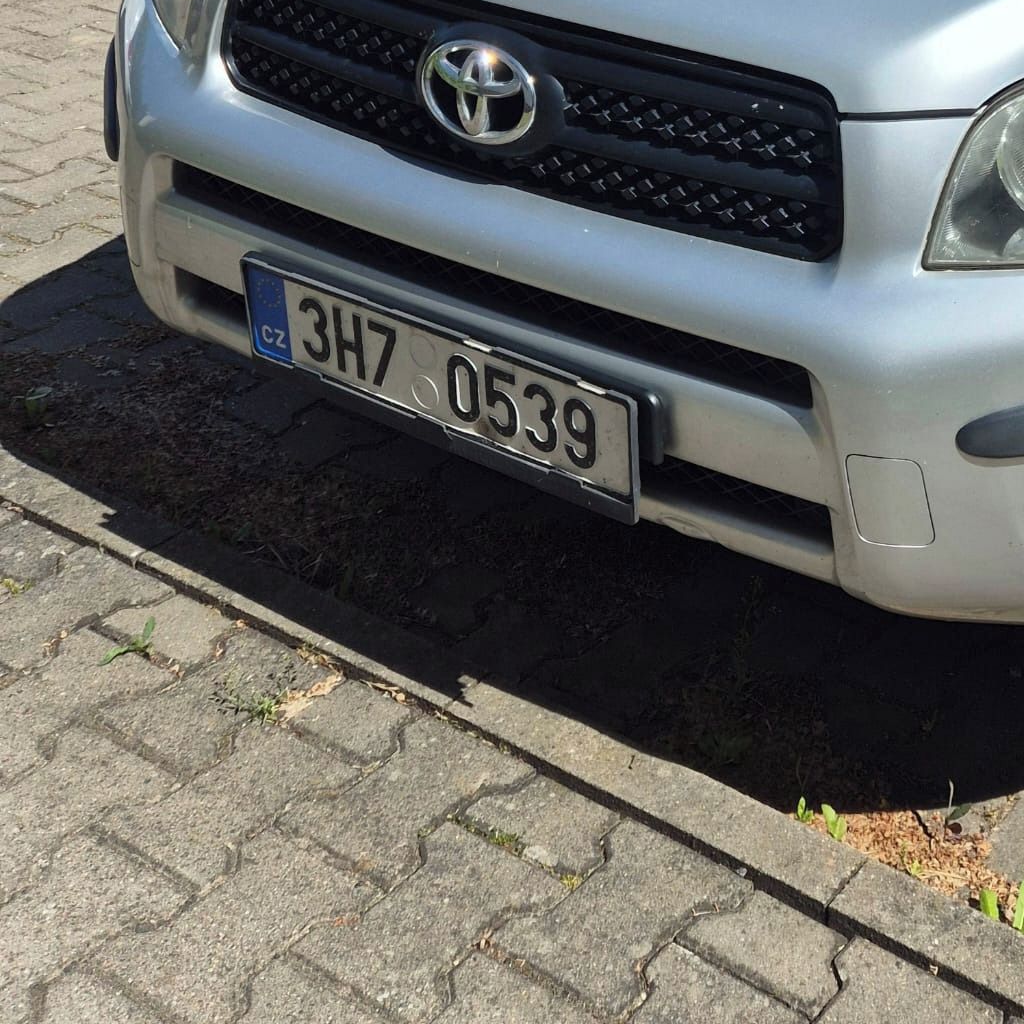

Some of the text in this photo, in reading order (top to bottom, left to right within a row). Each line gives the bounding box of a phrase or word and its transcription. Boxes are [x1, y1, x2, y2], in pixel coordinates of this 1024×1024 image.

[261, 323, 287, 349] CZ
[298, 297, 597, 470] 3H7 0539
